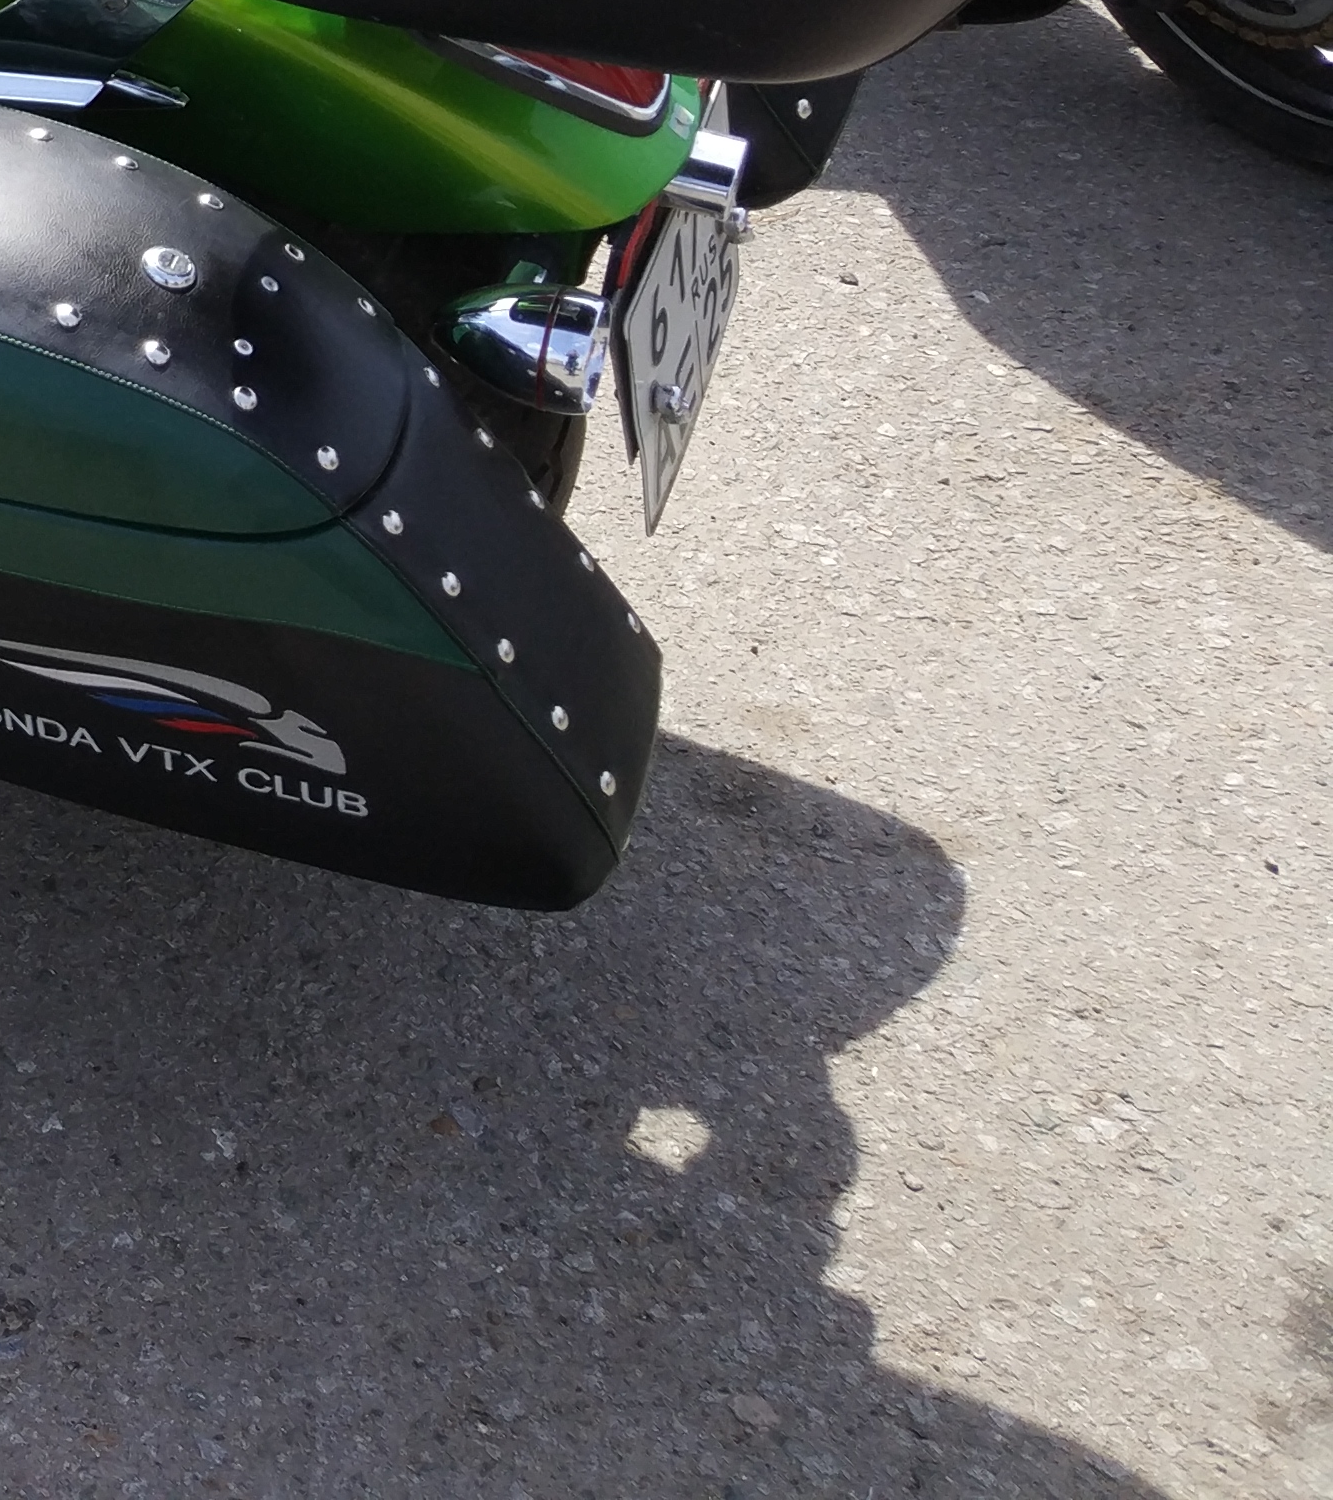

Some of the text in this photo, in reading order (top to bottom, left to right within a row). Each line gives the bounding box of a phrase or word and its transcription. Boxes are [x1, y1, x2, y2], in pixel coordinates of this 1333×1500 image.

[690, 233, 718, 312] RUS
[702, 238, 734, 366] 25
[118, 735, 219, 784] VTX
[237, 766, 370, 818] CLUB
